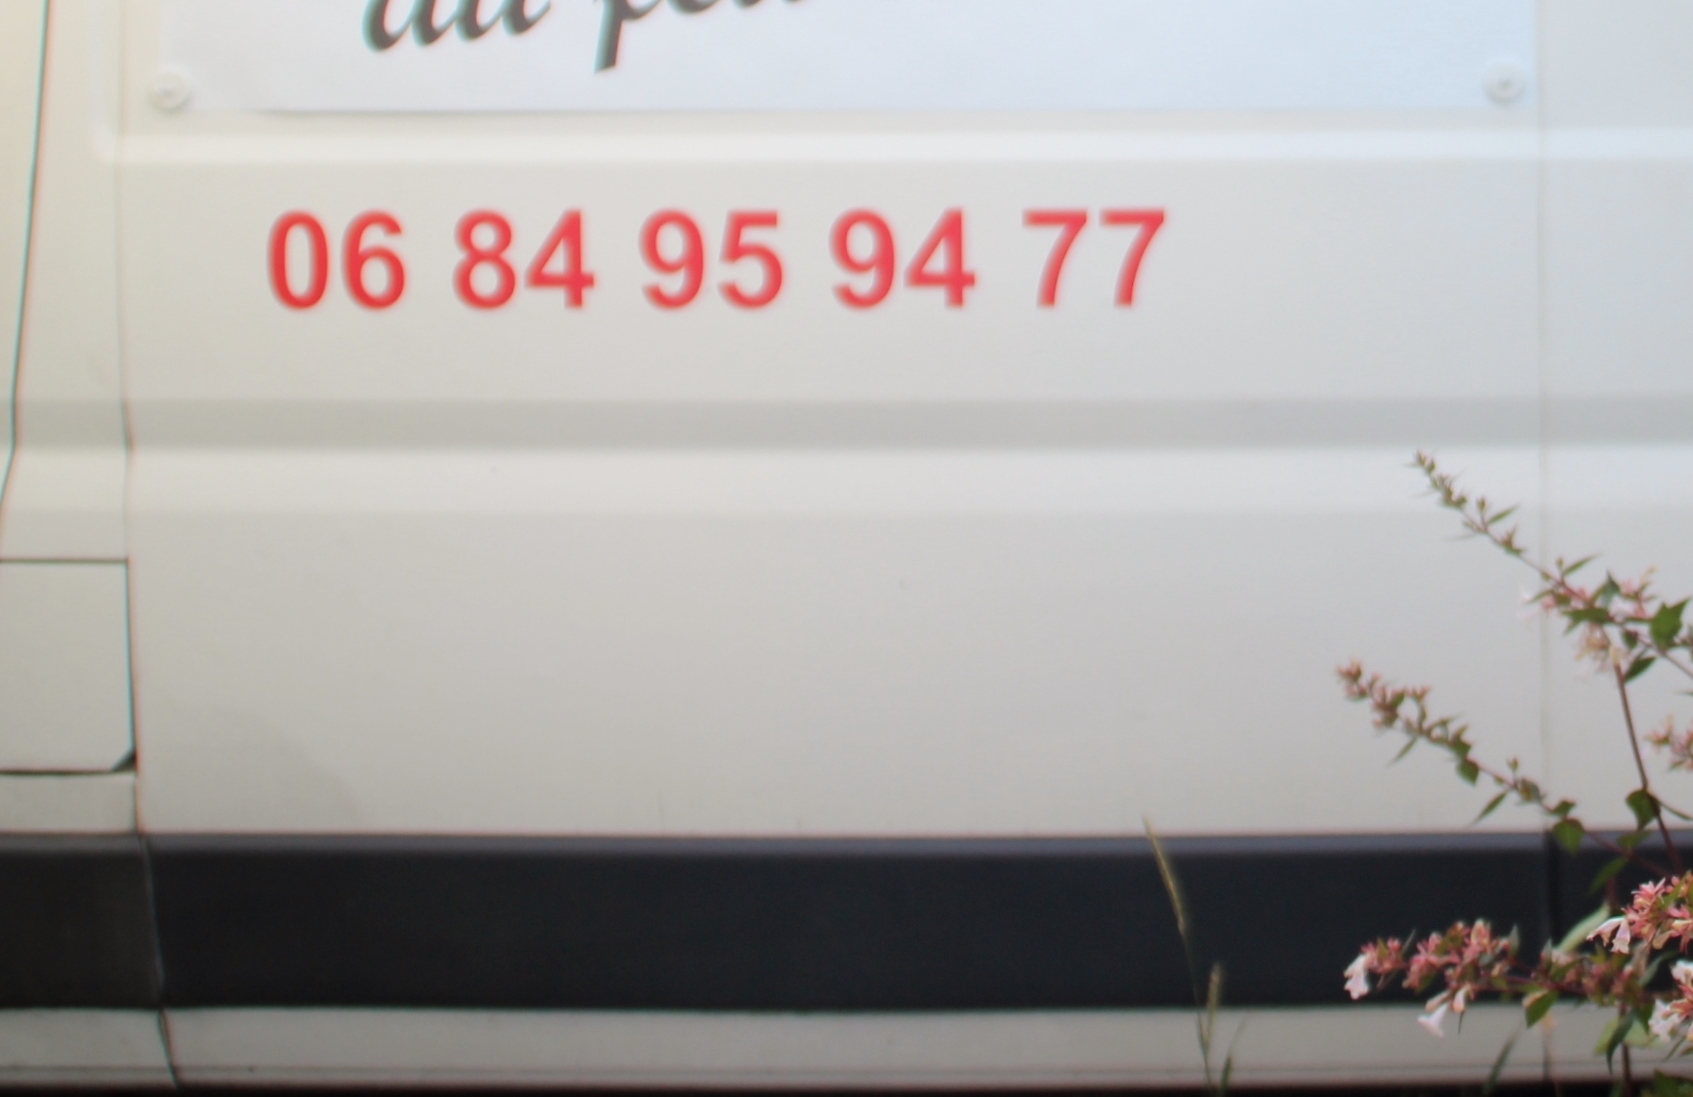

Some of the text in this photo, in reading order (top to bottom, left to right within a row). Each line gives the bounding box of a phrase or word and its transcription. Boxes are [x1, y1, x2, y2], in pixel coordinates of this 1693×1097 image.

[267, 208, 1168, 312] 06 84 95 94 77
